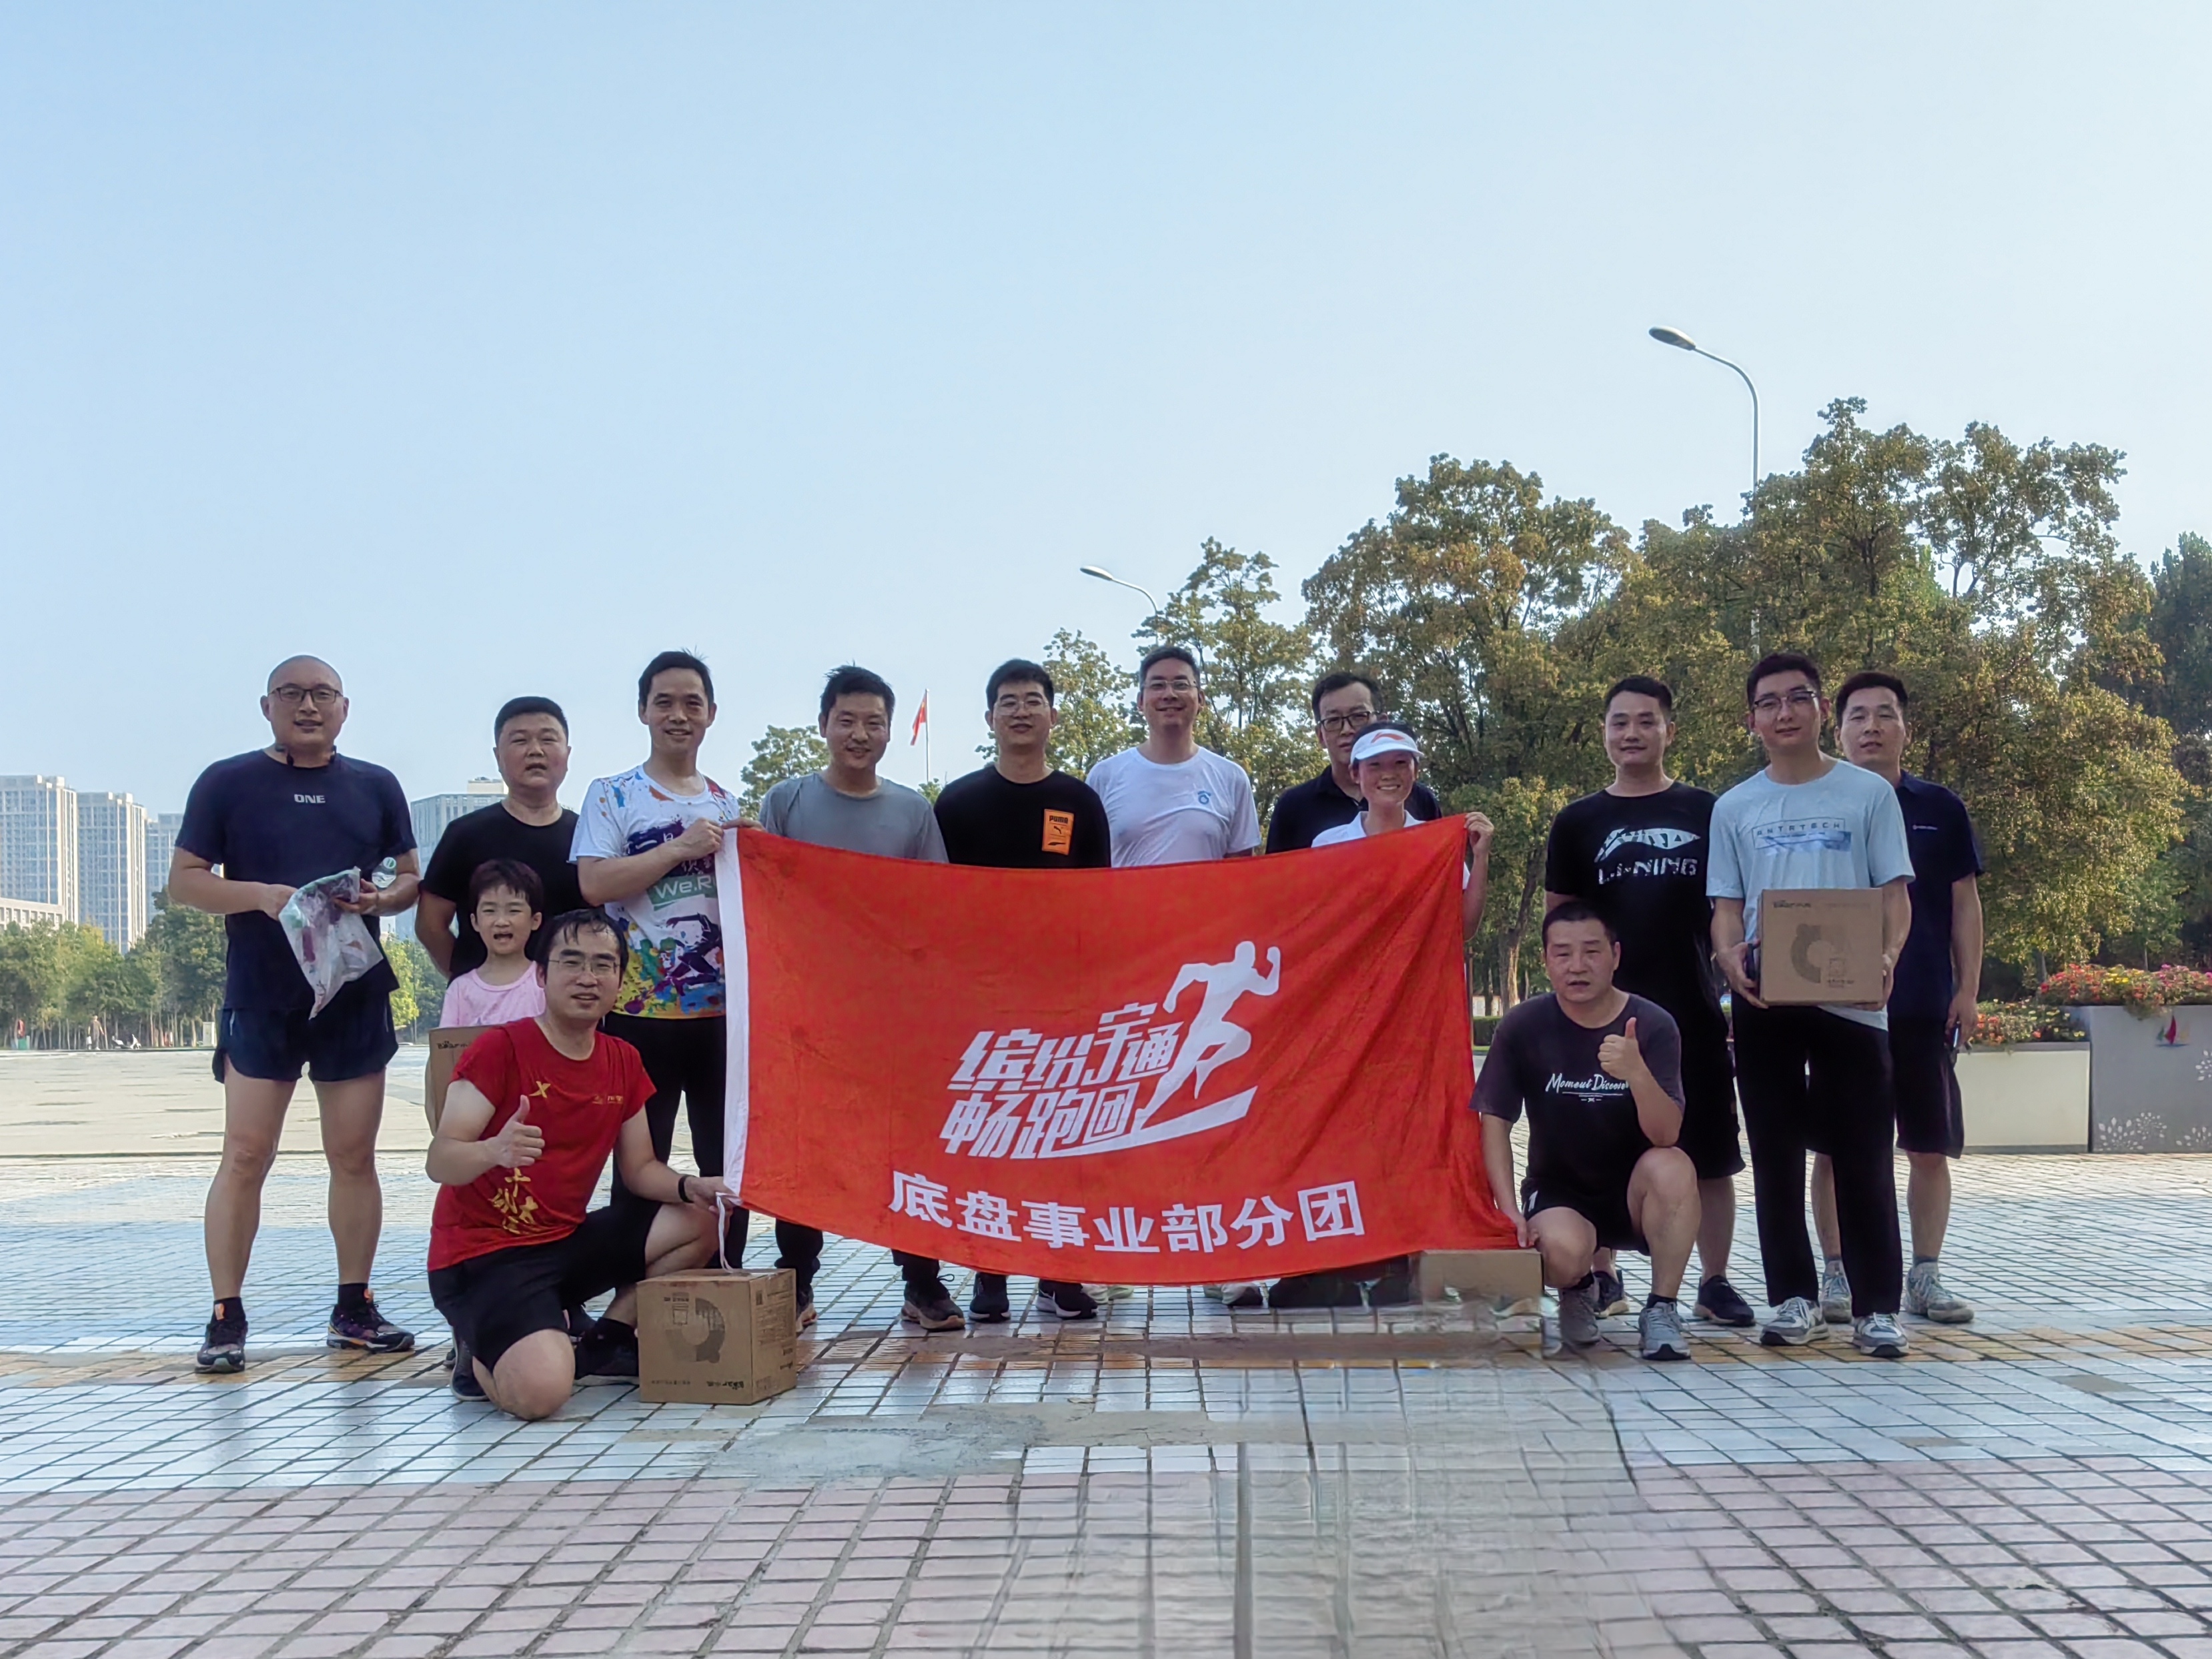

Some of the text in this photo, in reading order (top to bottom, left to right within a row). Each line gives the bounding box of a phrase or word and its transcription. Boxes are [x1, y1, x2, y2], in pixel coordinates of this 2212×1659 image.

[294, 794, 326, 804] ONE
[1049, 815, 1068, 824] PUMA
[947, 1002, 1184, 1091] 缤纷宇通
[939, 1082, 1139, 1159] 畅跑团
[889, 1170, 1365, 1253] 底盘事业部分团
